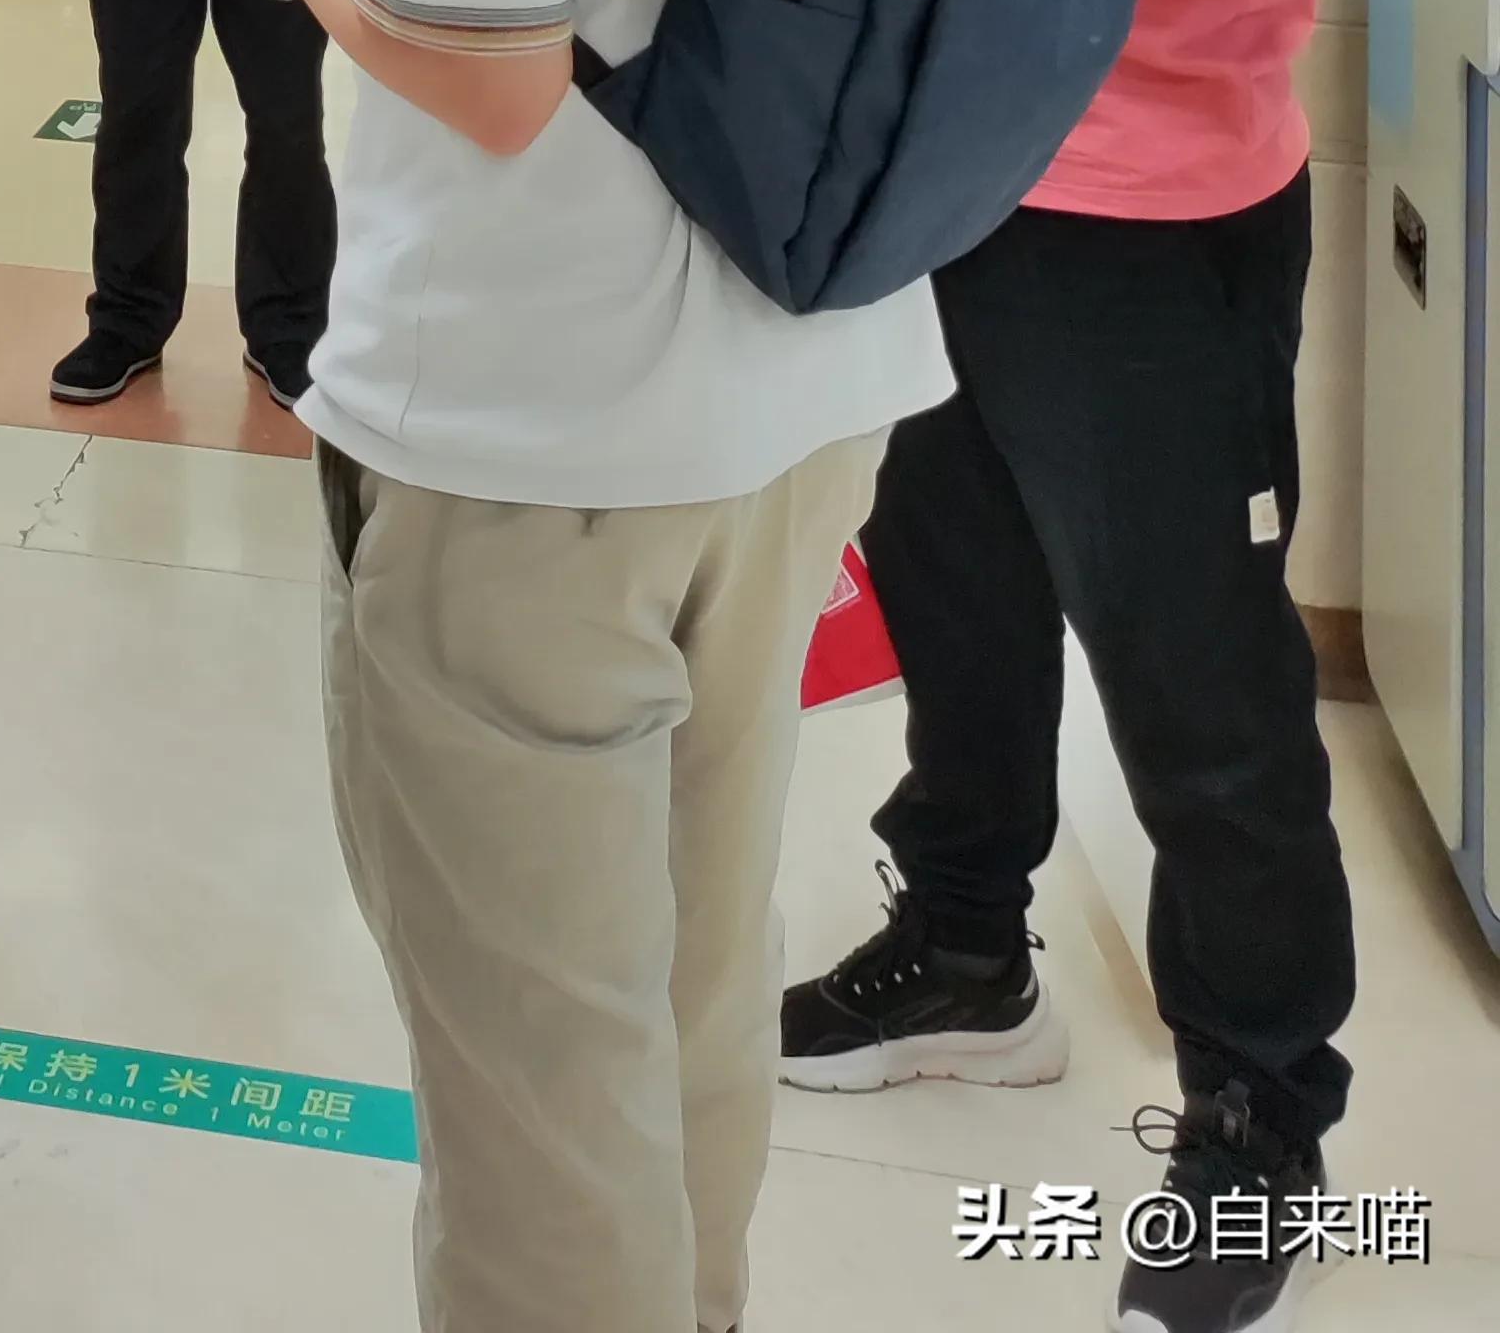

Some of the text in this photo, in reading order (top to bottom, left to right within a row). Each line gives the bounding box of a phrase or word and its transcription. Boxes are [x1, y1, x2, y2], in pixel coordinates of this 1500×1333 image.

[27, 1078, 179, 1116] Distance
[210, 1106, 220, 1123] 1
[246, 1112, 347, 1142] Meter
